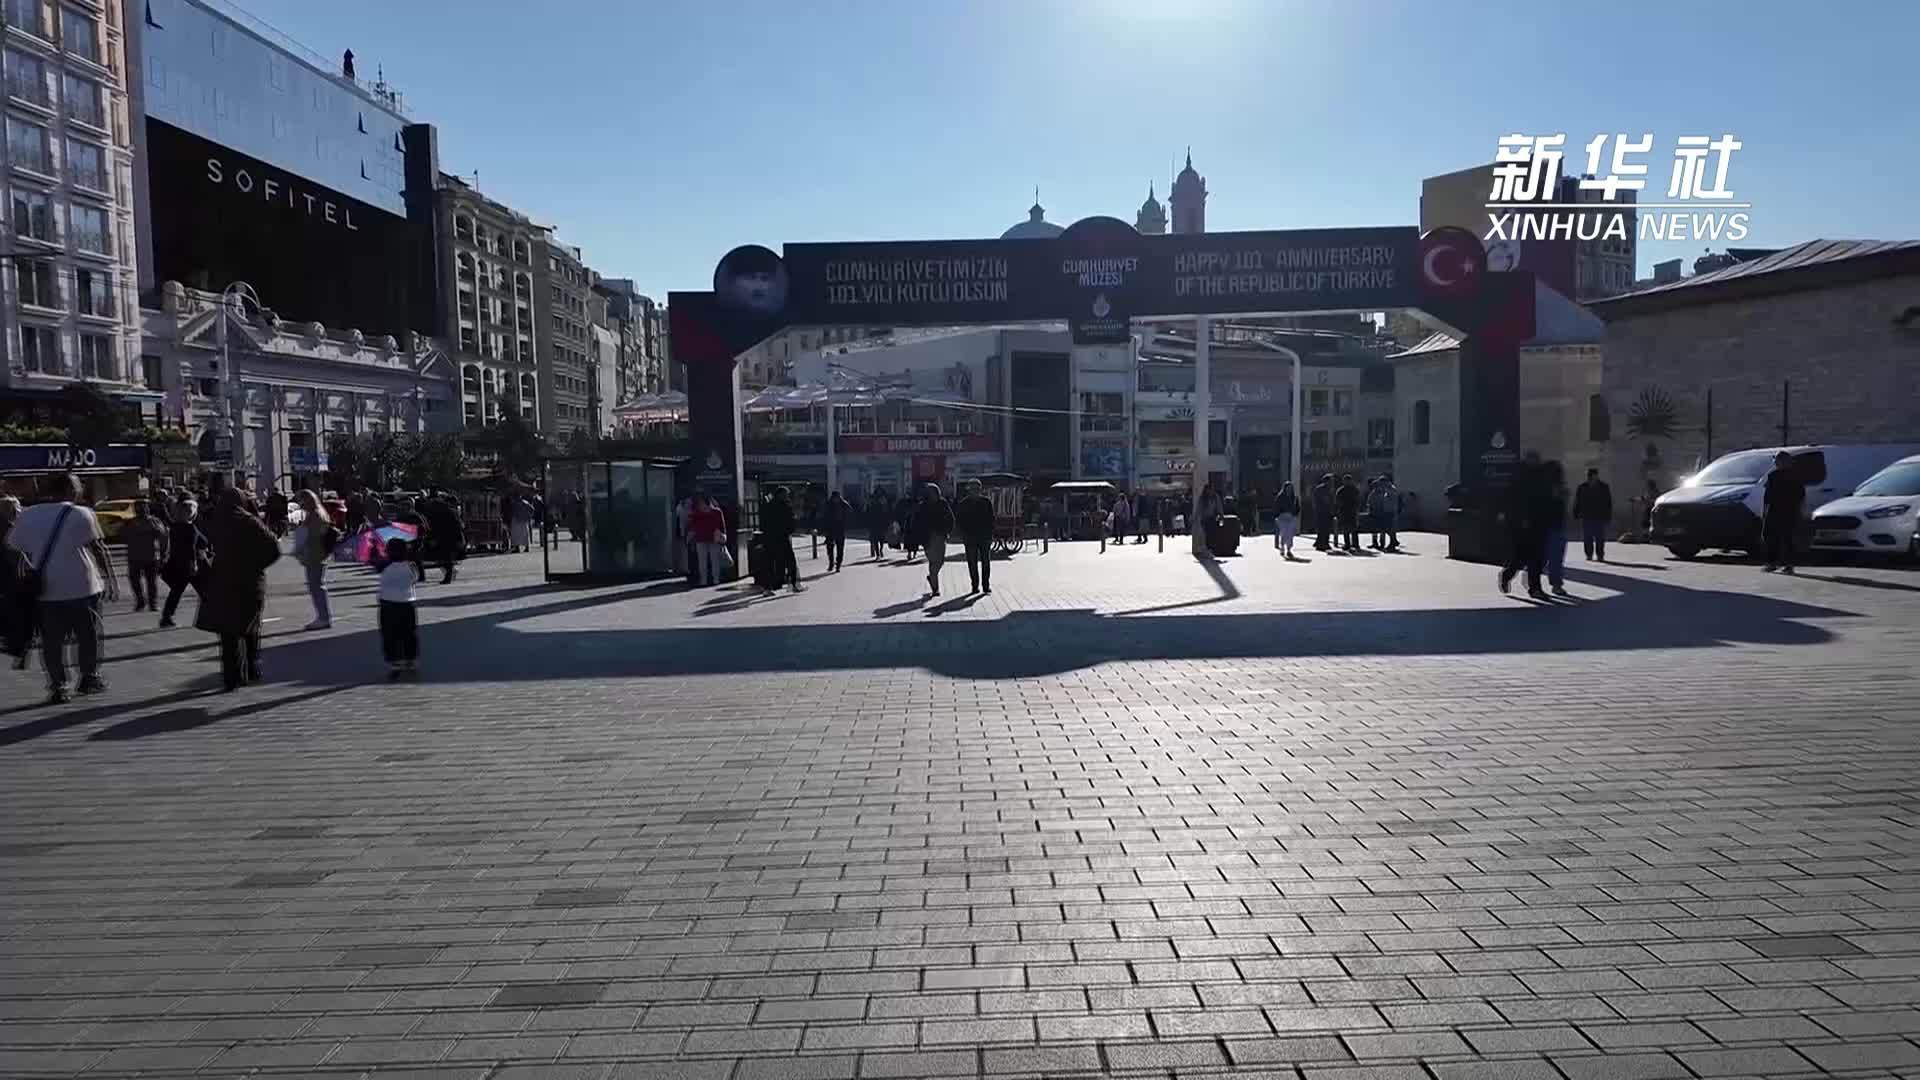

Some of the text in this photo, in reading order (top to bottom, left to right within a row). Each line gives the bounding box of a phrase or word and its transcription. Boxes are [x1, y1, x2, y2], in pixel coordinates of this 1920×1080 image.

[207, 158, 359, 231] SOFITEL
[1175, 252, 1229, 273] HAPPY
[1277, 247, 1394, 268] ANNIVERSARY
[897, 282, 950, 302] KUTLU
[953, 280, 1008, 301] OLSUN
[1175, 277, 1194, 296] OF
[1196, 276, 1225, 295] THE
[1229, 272, 1304, 294] REPUBLIC
[1306, 271, 1327, 289] OF
